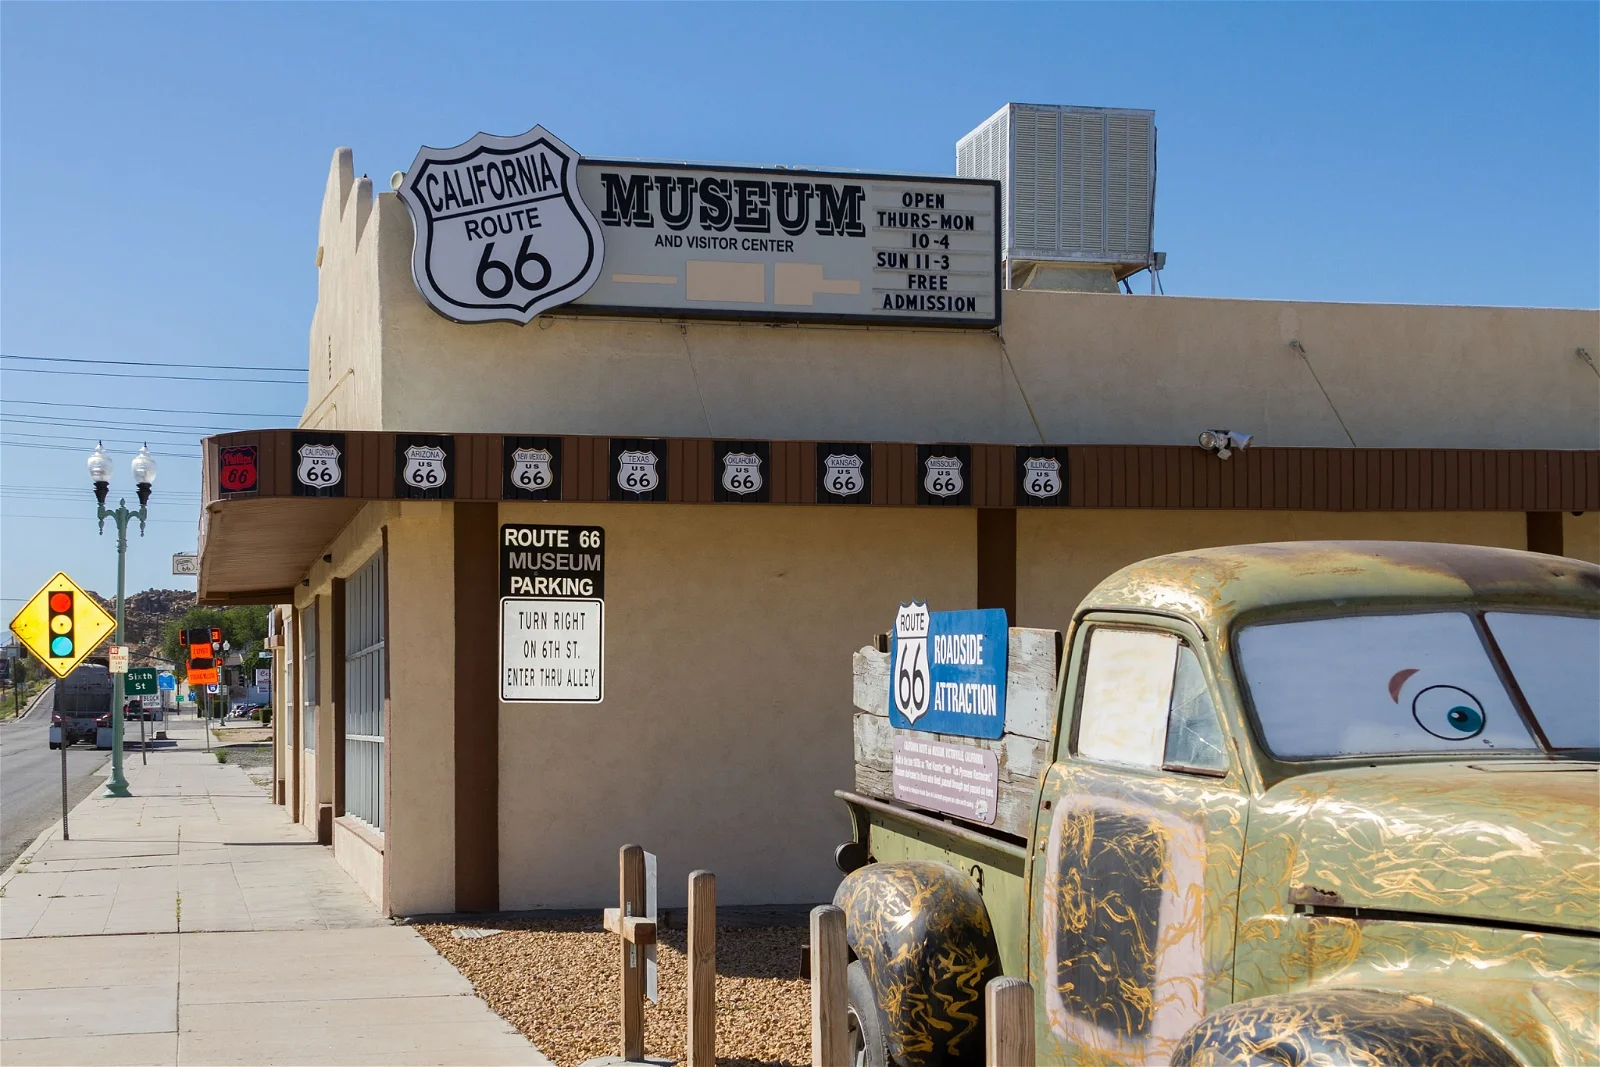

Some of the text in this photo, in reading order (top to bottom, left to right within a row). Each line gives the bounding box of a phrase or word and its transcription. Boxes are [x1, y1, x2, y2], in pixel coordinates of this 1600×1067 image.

[426, 152, 559, 214] CALIFORNIA
[600, 173, 866, 237] MUSEUM
[902, 192, 946, 210] OPEN
[466, 207, 542, 242] ROUTE
[876, 211, 975, 231] THURS-MON
[654, 234, 794, 253] AND VISITOR CENTER
[476, 234, 552, 299] 66
[876, 251, 950, 270] SUN 11-3
[908, 274, 949, 291] FREE
[882, 293, 977, 313] ADMISSION
[223, 452, 253, 466] Phillips
[305, 448, 334, 456] CALIFORNIA
[411, 450, 440, 459] ARIZONA
[228, 469, 249, 484] 66
[307, 467, 332, 482] 66
[412, 469, 437, 484] 66
[520, 471, 544, 485] 66
[626, 473, 650, 487] 66
[731, 475, 754, 489] 66
[833, 476, 855, 491] 66
[933, 477, 956, 492] 66
[1031, 479, 1054, 492] 66
[505, 528, 600, 548] ROUTE 66
[509, 552, 600, 571] MUSEUM
[511, 576, 593, 596] PARKING
[519, 611, 585, 630] TURN RIGHT
[900, 612, 925, 632] ROUTE
[523, 640, 580, 659] ON 6TH ST.
[934, 634, 983, 665] ROADSIDE
[507, 668, 595, 687] ENTER THRU ALLEY
[899, 642, 925, 711] 66
[934, 682, 997, 716] ATTRACTION
